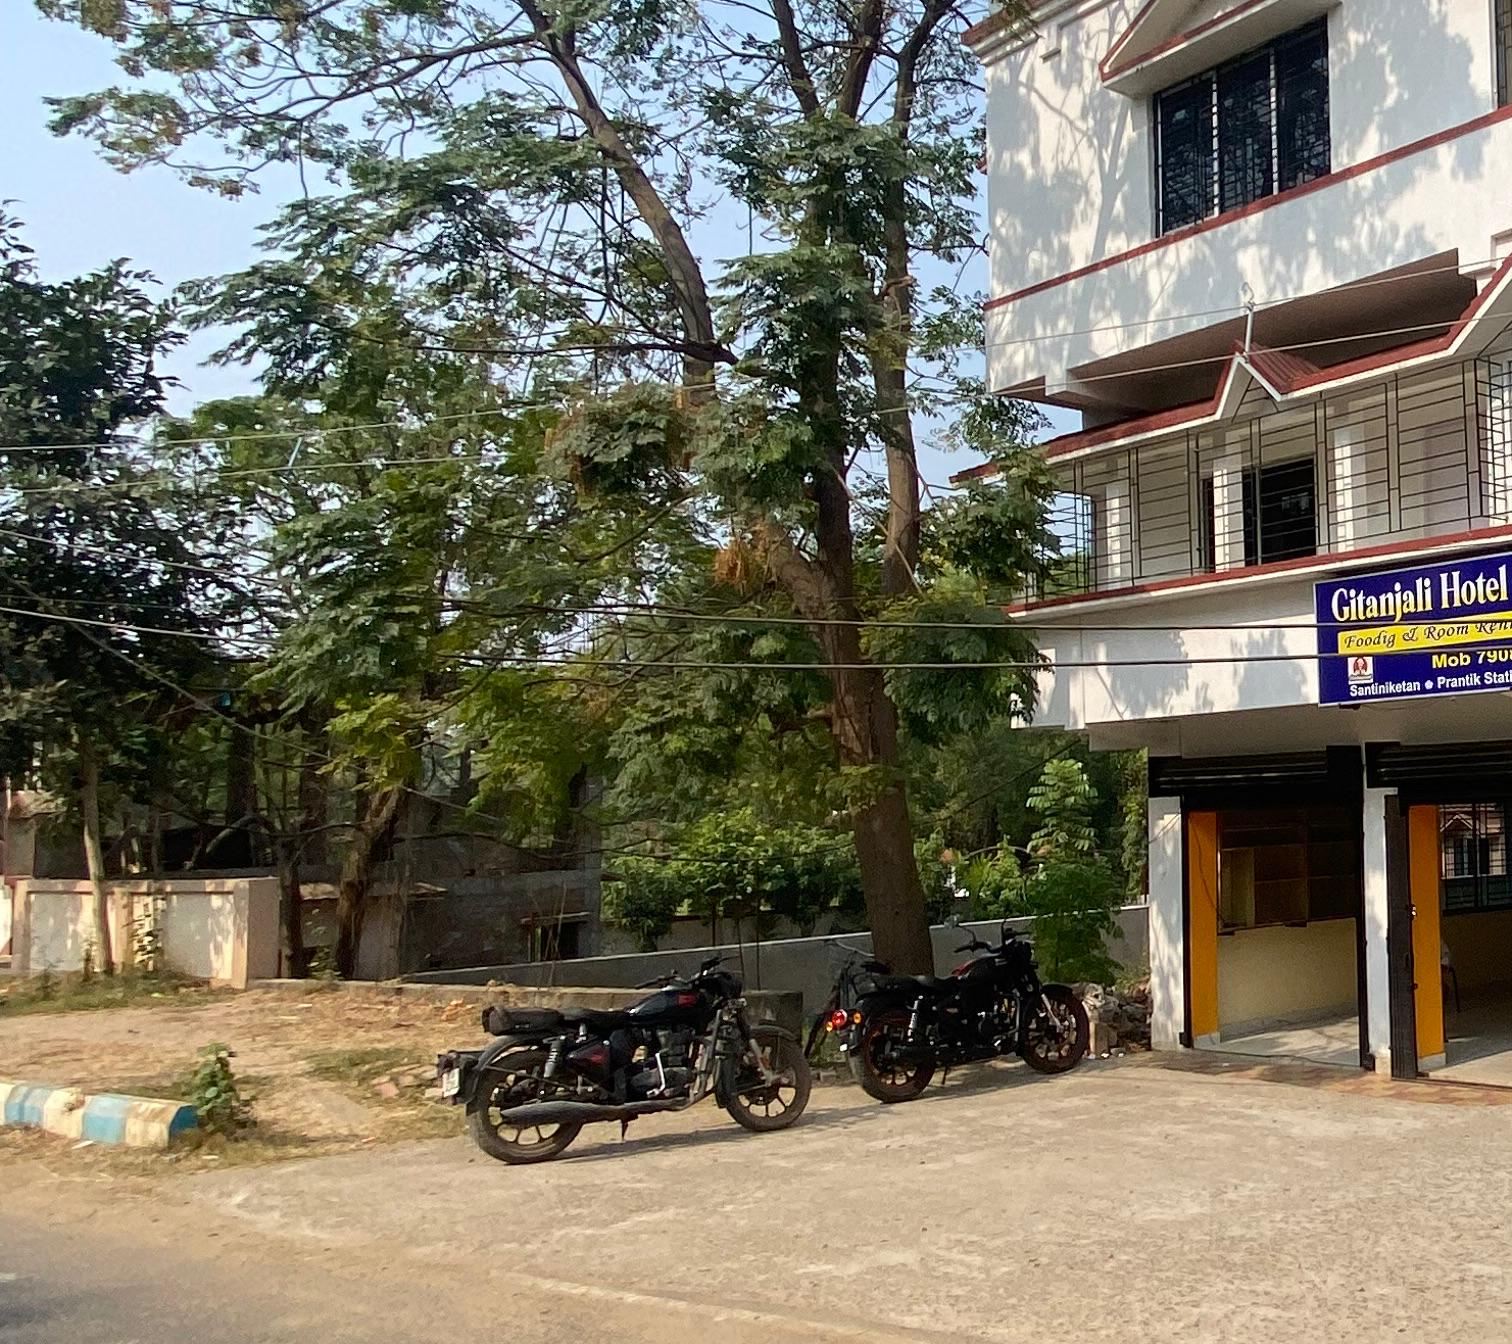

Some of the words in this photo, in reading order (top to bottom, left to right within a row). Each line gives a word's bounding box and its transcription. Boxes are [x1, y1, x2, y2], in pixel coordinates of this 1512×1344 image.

[1331, 576, 1433, 623] Gitanjali
[1439, 563, 1509, 609] Hotel
[1344, 629, 1396, 649] Foodig
[1423, 623, 1469, 641] Room
[1431, 652, 1472, 669] Mob
[1350, 680, 1421, 698] Santiniketan
[1436, 672, 1481, 690] Prantik
